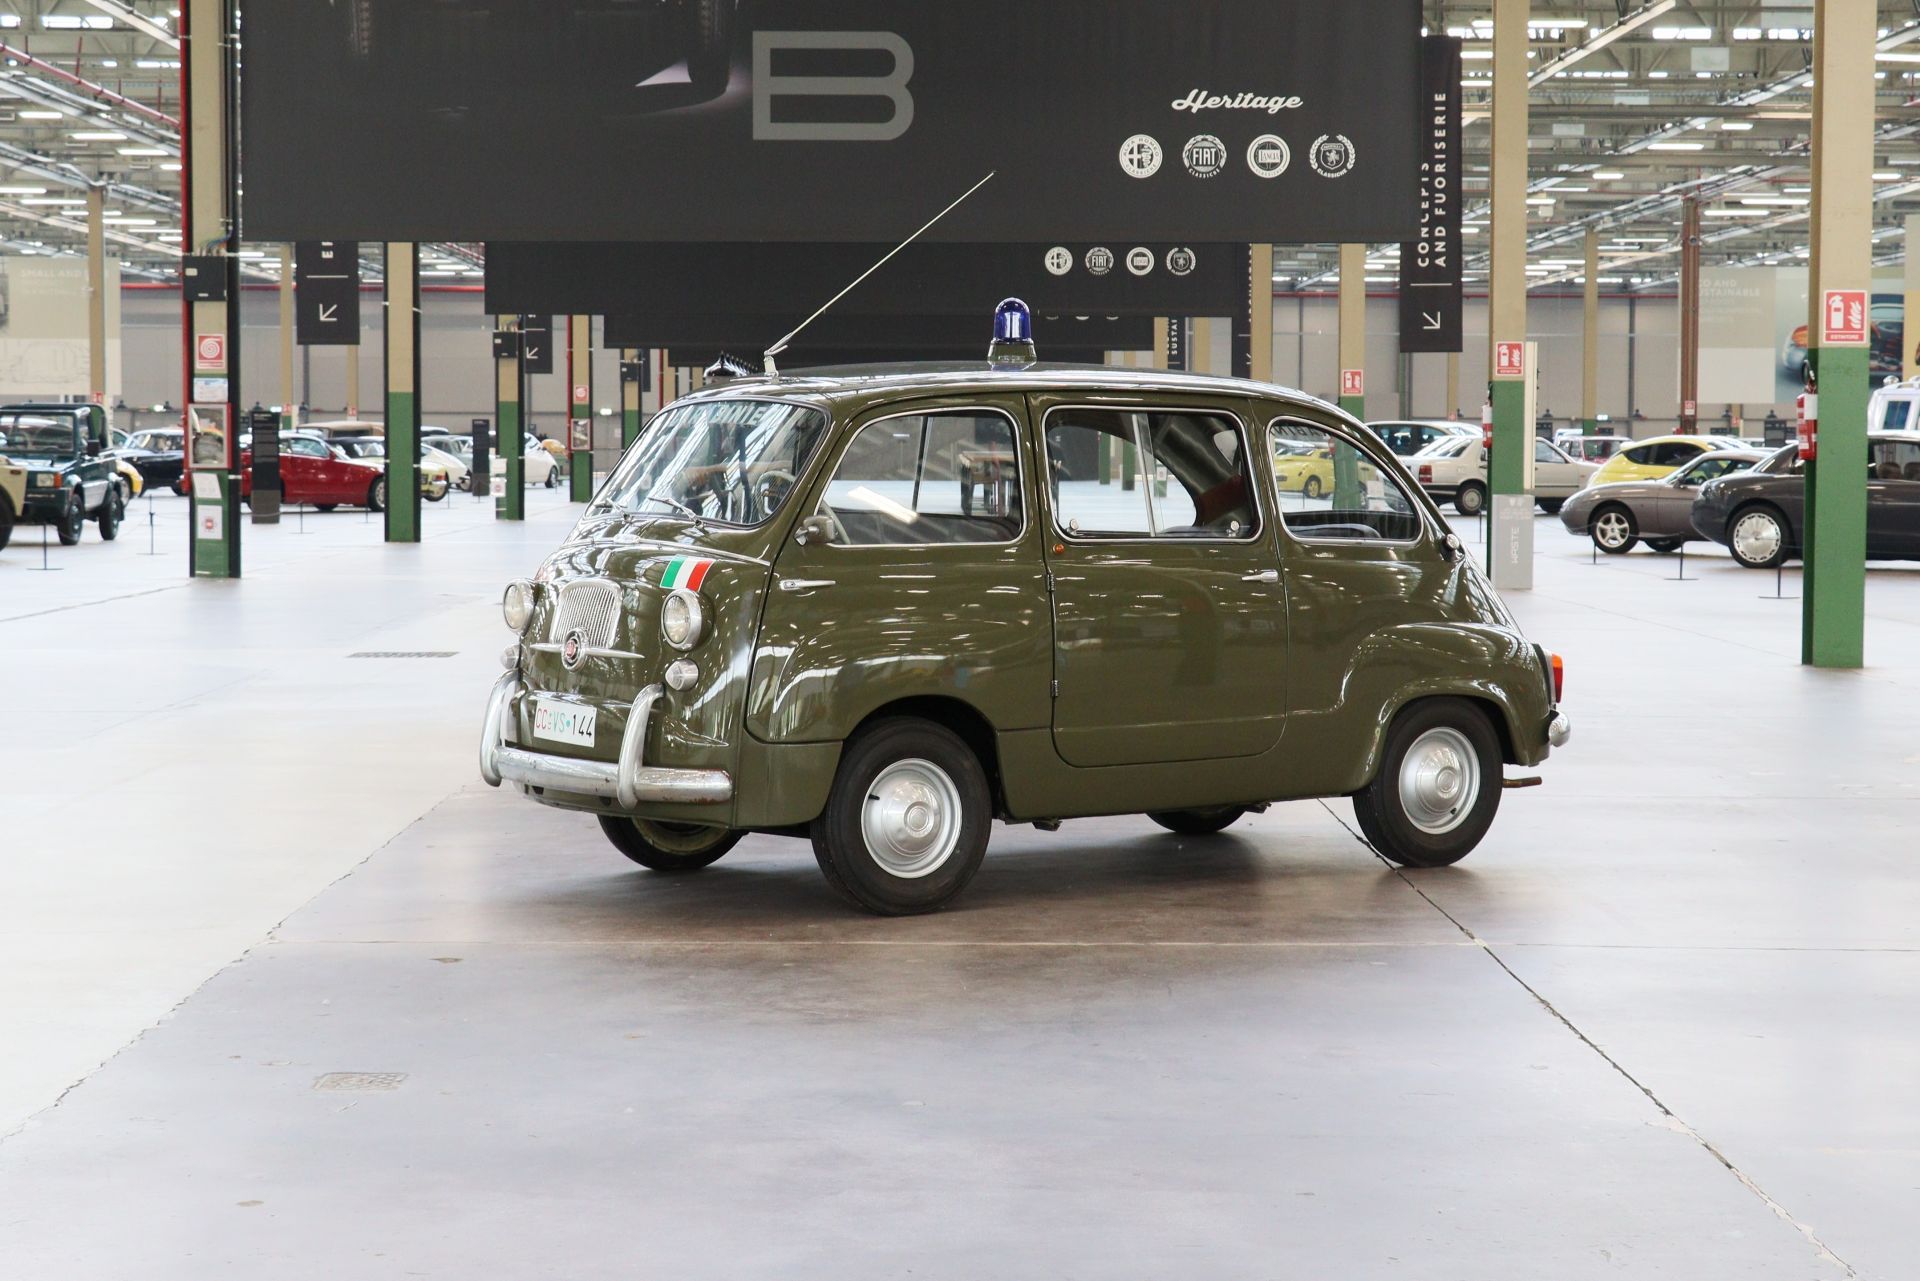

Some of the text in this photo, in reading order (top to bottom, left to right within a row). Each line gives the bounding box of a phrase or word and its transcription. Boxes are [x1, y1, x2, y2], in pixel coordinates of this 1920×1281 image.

[752, 30, 915, 141] B
[1171, 88, 1304, 114] Heritage
[1192, 148, 1217, 166] FIAT
[1434, 93, 1446, 267] AND FUORISERIE
[1091, 255, 1108, 267] FIAT
